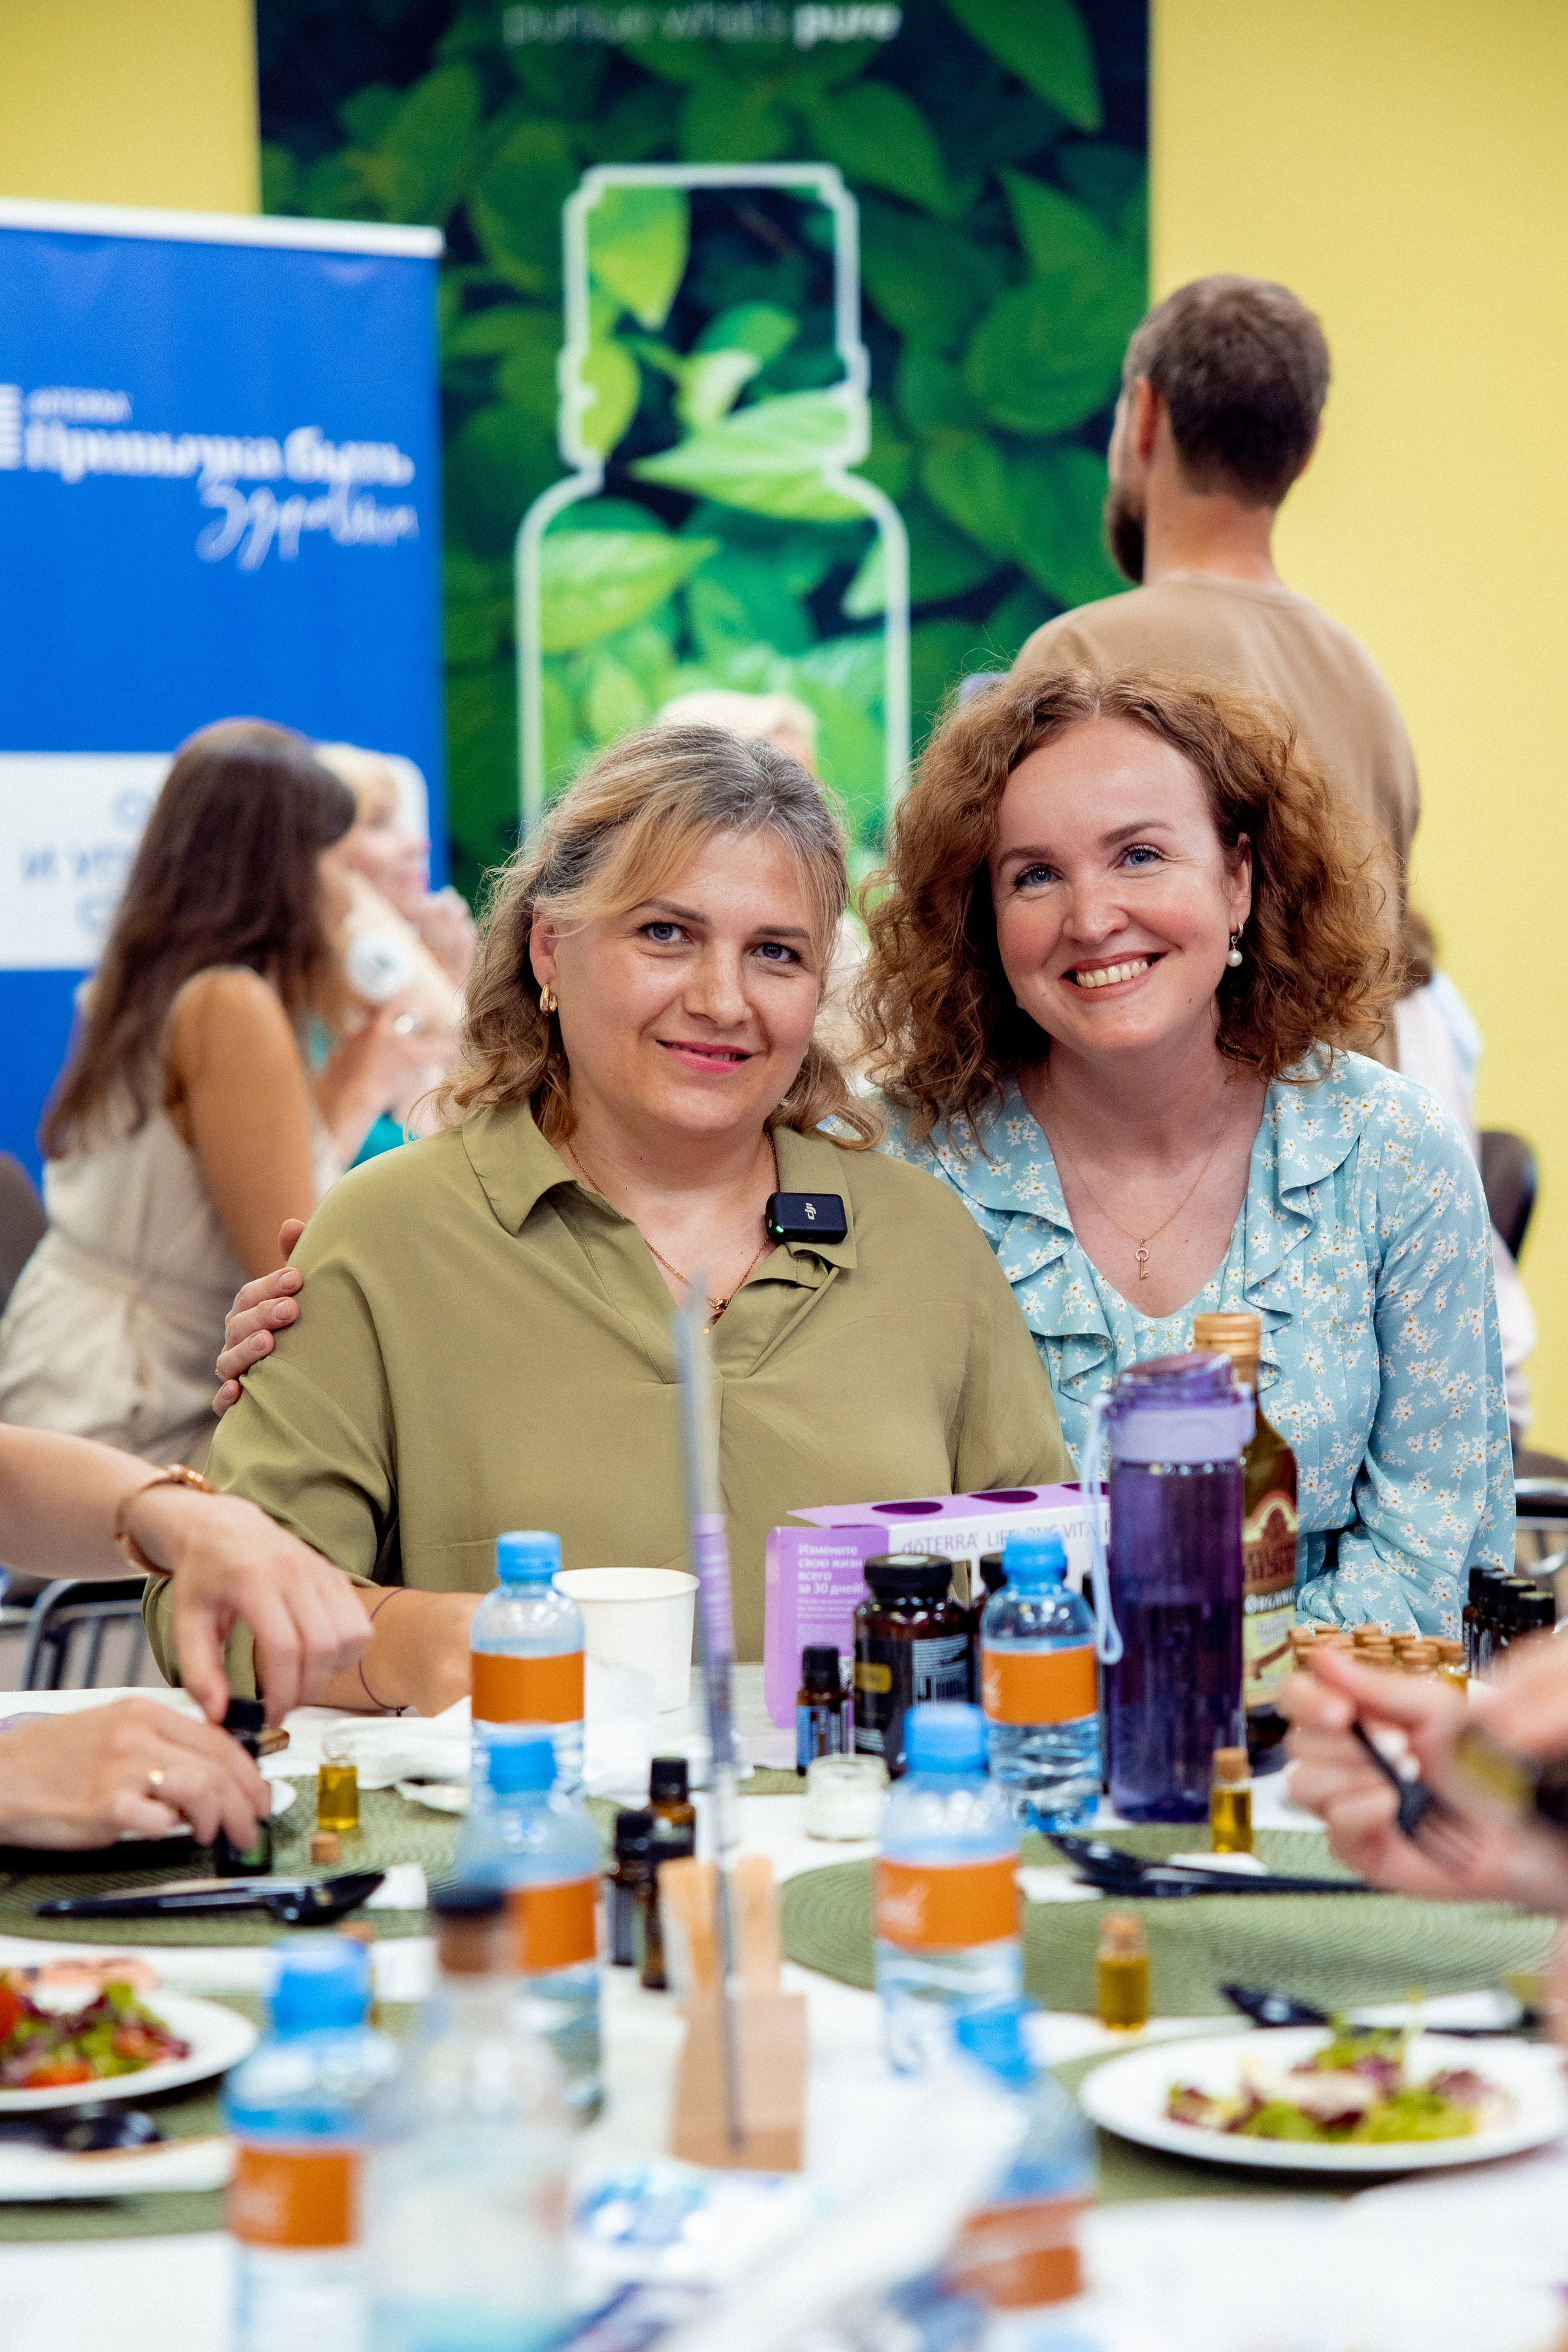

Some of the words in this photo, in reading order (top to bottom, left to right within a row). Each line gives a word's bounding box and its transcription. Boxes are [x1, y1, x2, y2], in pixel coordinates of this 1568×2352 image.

[794, 5, 902, 50] pure
[804, 1202, 816, 1220] DJI
[832, 1559, 863, 1568] жизн
[814, 1581, 829, 1594] 30
